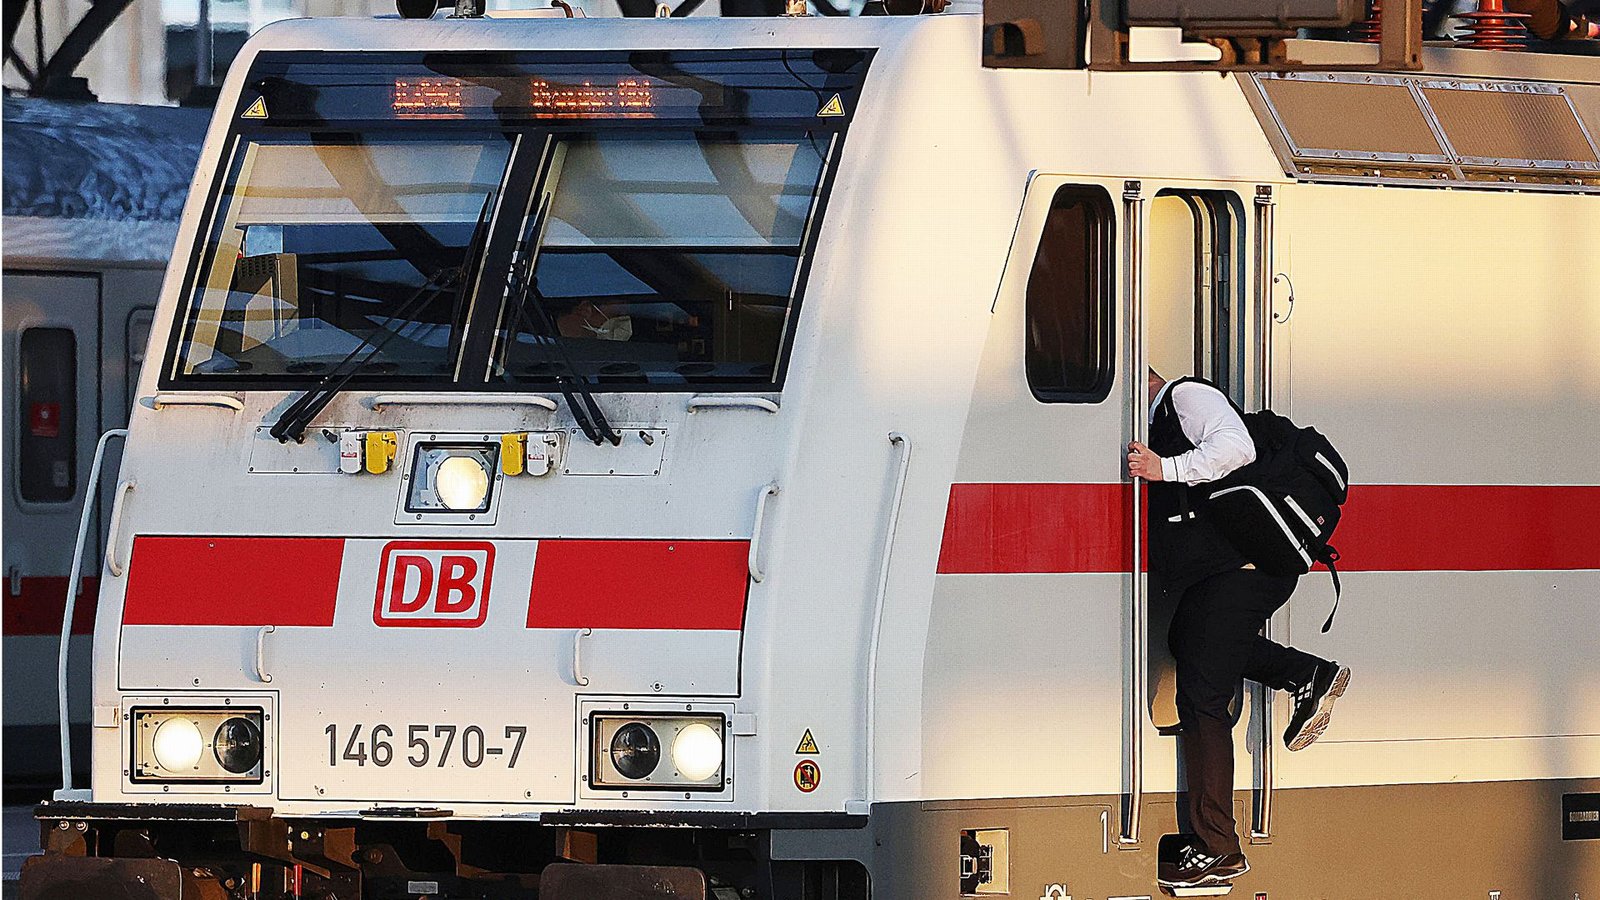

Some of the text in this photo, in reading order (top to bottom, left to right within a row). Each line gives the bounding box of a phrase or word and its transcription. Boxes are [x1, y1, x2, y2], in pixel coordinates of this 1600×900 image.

[389, 555, 478, 613] DB
[325, 723, 527, 768] 146 570-7
[1100, 810, 1108, 853] 1
